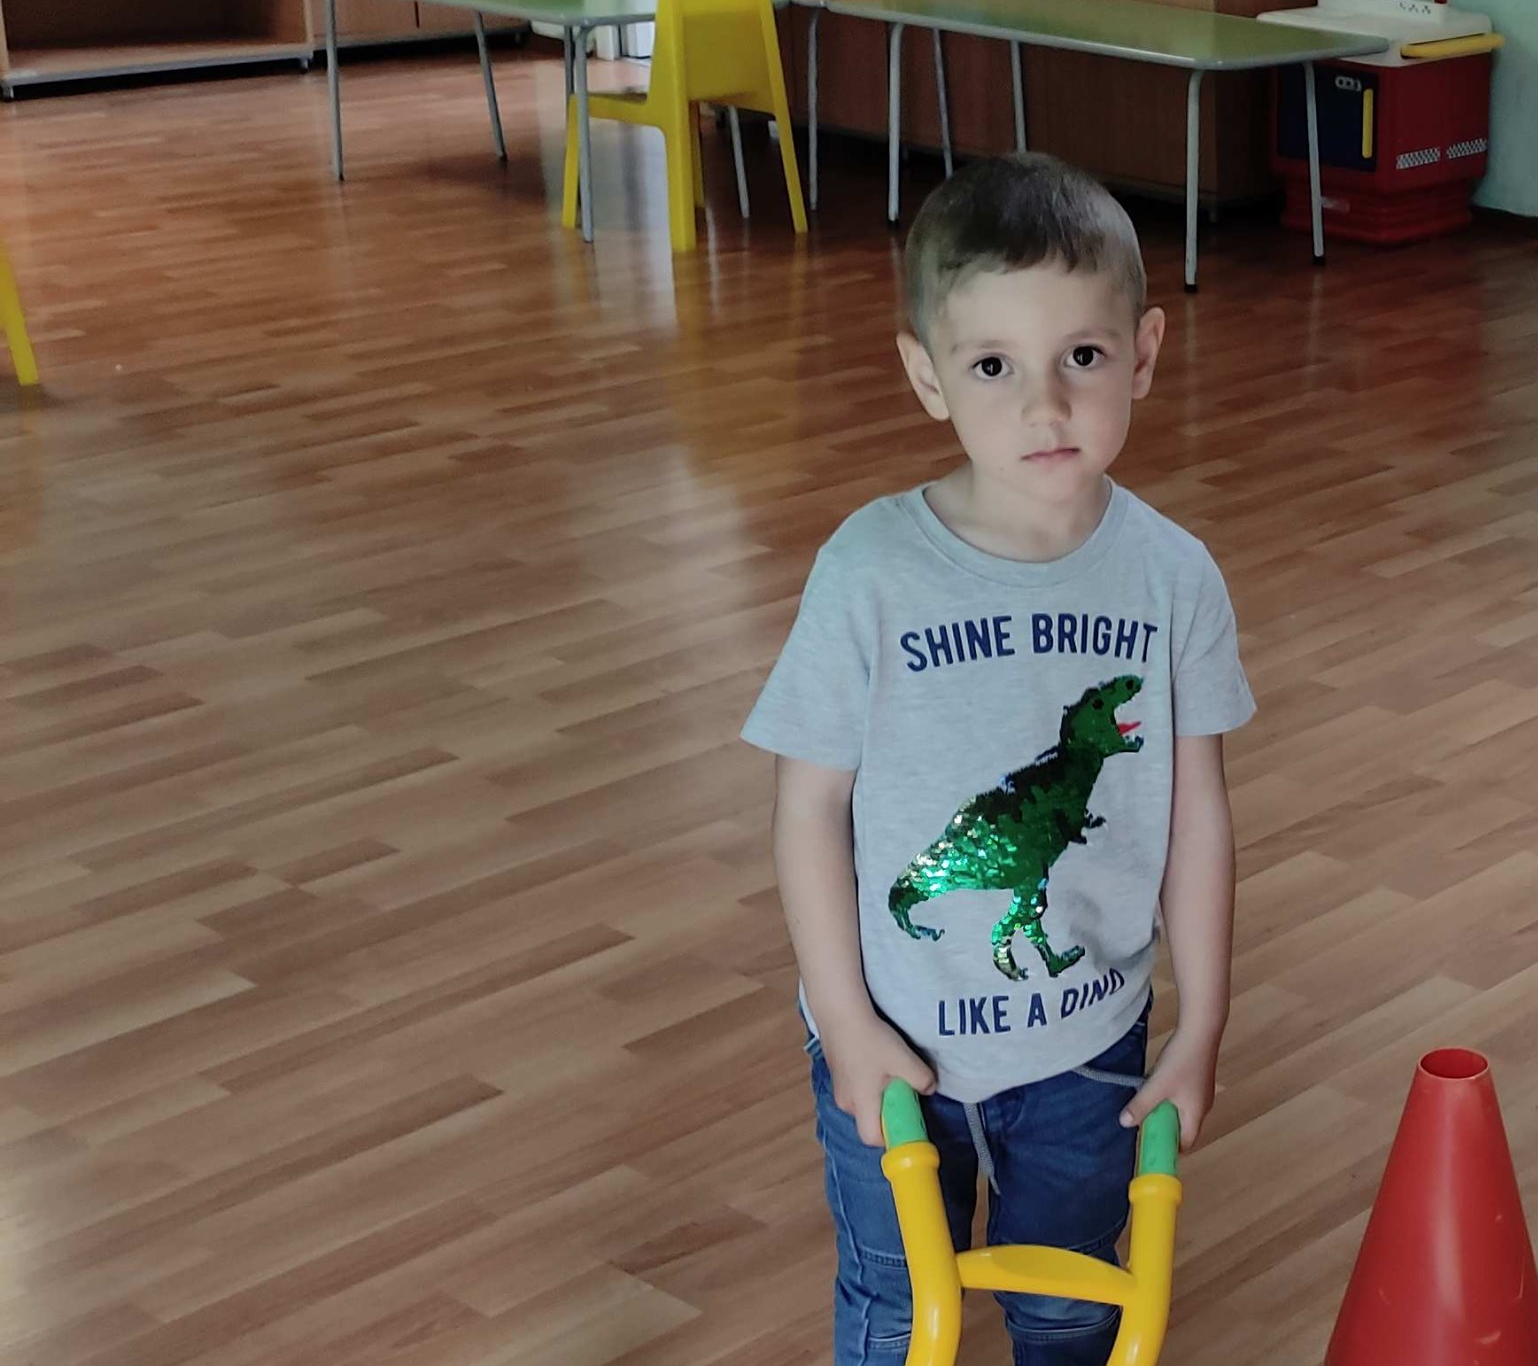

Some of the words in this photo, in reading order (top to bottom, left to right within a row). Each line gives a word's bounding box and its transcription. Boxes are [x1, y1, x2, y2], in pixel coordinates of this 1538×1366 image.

[900, 615, 1016, 672] SHINE
[1031, 613, 1158, 663] BRIGHT
[938, 995, 1011, 1036] LIKE
[1027, 992, 1047, 1028] A
